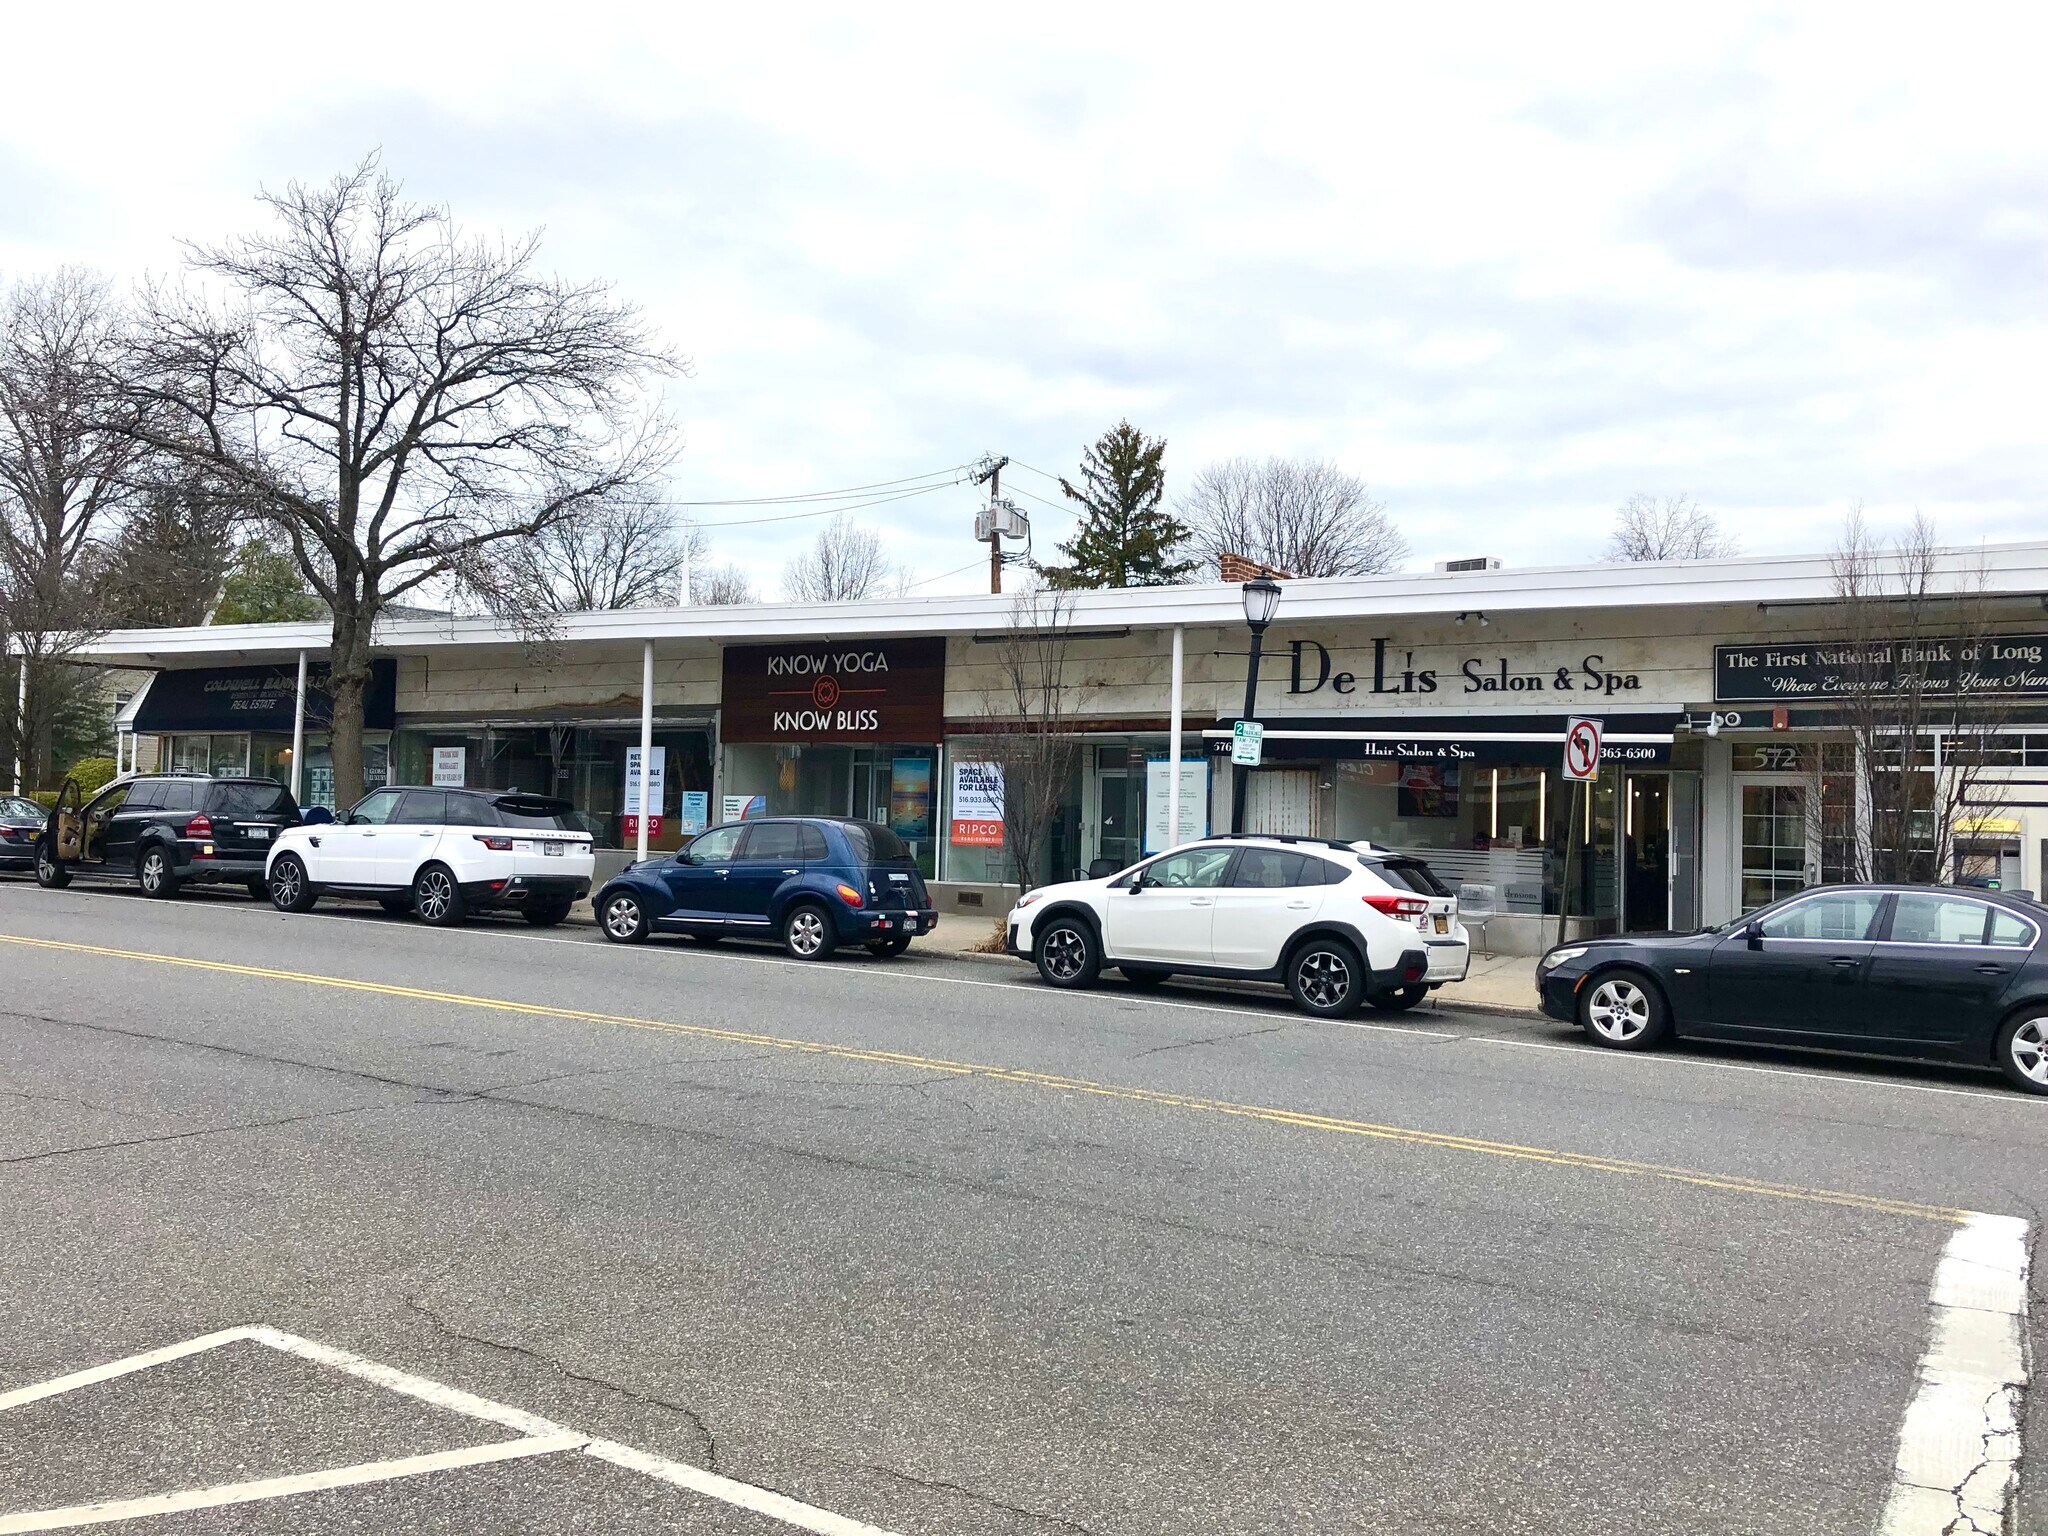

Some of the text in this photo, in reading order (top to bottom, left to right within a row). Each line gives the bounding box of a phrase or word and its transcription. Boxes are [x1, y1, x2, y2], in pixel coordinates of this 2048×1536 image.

[1726, 643, 2042, 668] The First National Bank of Long
[767, 652, 889, 676] KNOW YOGA
[1286, 640, 1356, 694] De
[1462, 658, 1545, 694] Salon
[1553, 667, 1574, 690] &
[1582, 655, 1642, 696] Spa
[204, 676, 315, 692] COLDWELL BANKR
[1957, 672, 2001, 692] Your
[231, 699, 277, 710] REAL ESTATE
[774, 709, 879, 731] KNOW BLISS
[1236, 724, 1243, 735] 2
[1214, 742, 1656, 759] 576 Hair Salon & Spa 365-6500
[1754, 747, 1796, 768] 572
[959, 768, 982, 776] SPACE
[959, 776, 999, 784] AVAILABLE
[959, 783, 998, 792] FOR LEASE
[959, 824, 997, 835] RIPCO
